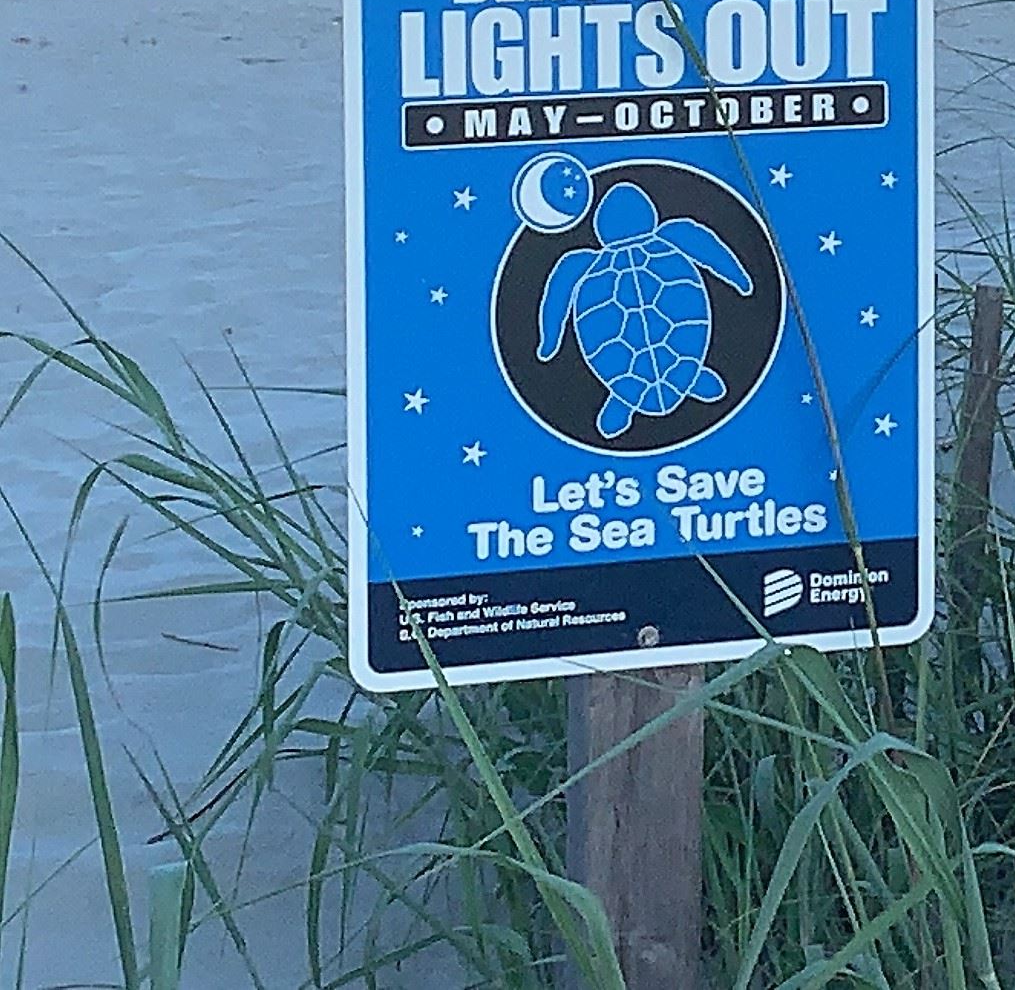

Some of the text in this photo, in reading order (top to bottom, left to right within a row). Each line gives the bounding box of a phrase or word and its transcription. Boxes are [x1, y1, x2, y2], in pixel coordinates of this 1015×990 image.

[400, 1, 685, 97] LIGHTS
[532, 464, 766, 513] Let's Save
[467, 498, 828, 560] The Sea Turtles
[427, 611, 454, 623] Fish
[456, 607, 480, 621] and
[482, 604, 528, 618] Wildlife
[530, 600, 576, 614] Service
[468, 593, 489, 606] by:
[427, 621, 499, 640] Department
[501, 620, 514, 632] of
[516, 615, 560, 630] Natural
[562, 611, 627, 626] Resources
